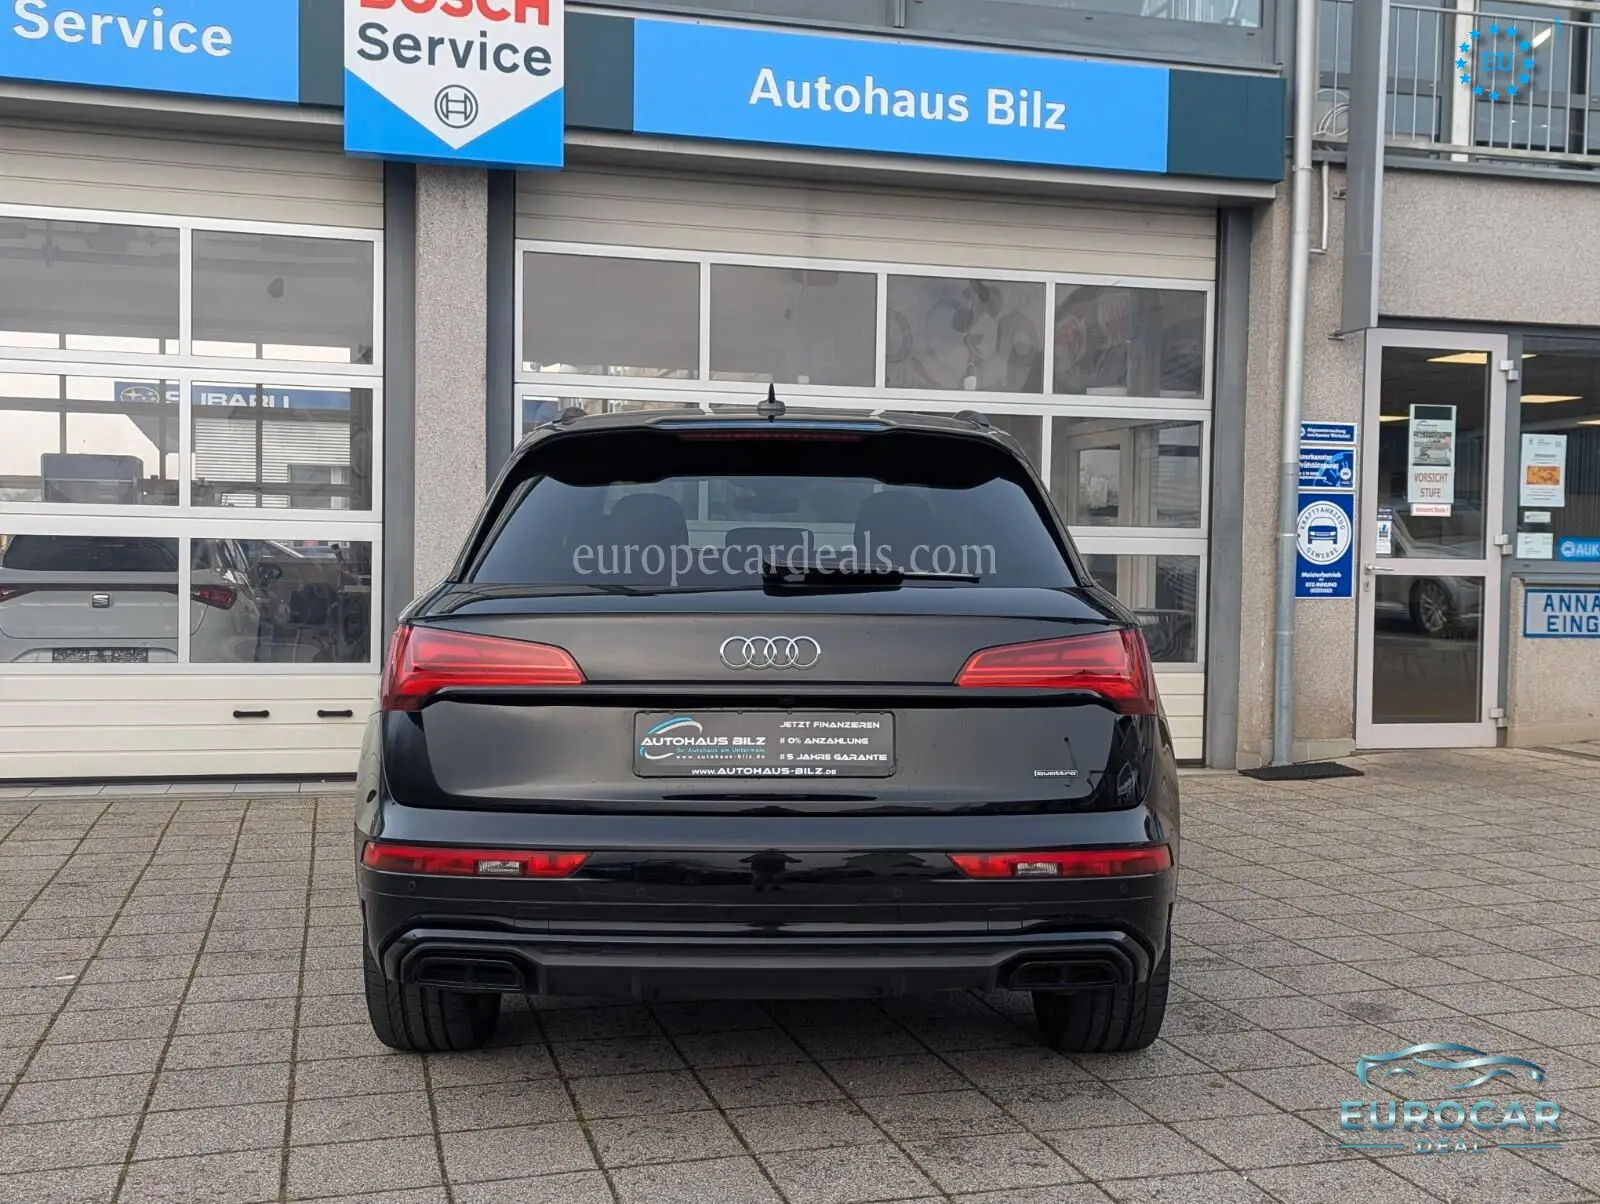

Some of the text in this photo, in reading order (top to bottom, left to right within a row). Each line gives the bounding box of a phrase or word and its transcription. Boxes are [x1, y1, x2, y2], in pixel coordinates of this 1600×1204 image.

[12, 0, 233, 58] Service
[356, 22, 552, 77] Service
[749, 67, 1067, 131] Autohaus Bilz
[1414, 472, 1449, 484] VORSICHT
[1419, 487, 1442, 498] STUFE
[1301, 507, 1346, 530] KRAFTFAHRZEUG
[1306, 547, 1339, 560] GEWERBE
[1543, 594, 1600, 613] ANNA
[1547, 615, 1600, 633] EING
[779, 721, 880, 729] JETZT FINANZIEREN
[640, 736, 767, 746] AUTOHAUS BILZ
[803, 737, 869, 745] ANZAHLUNG
[833, 753, 888, 761] GARANTIE
[1036, 770, 1076, 778] quattro
